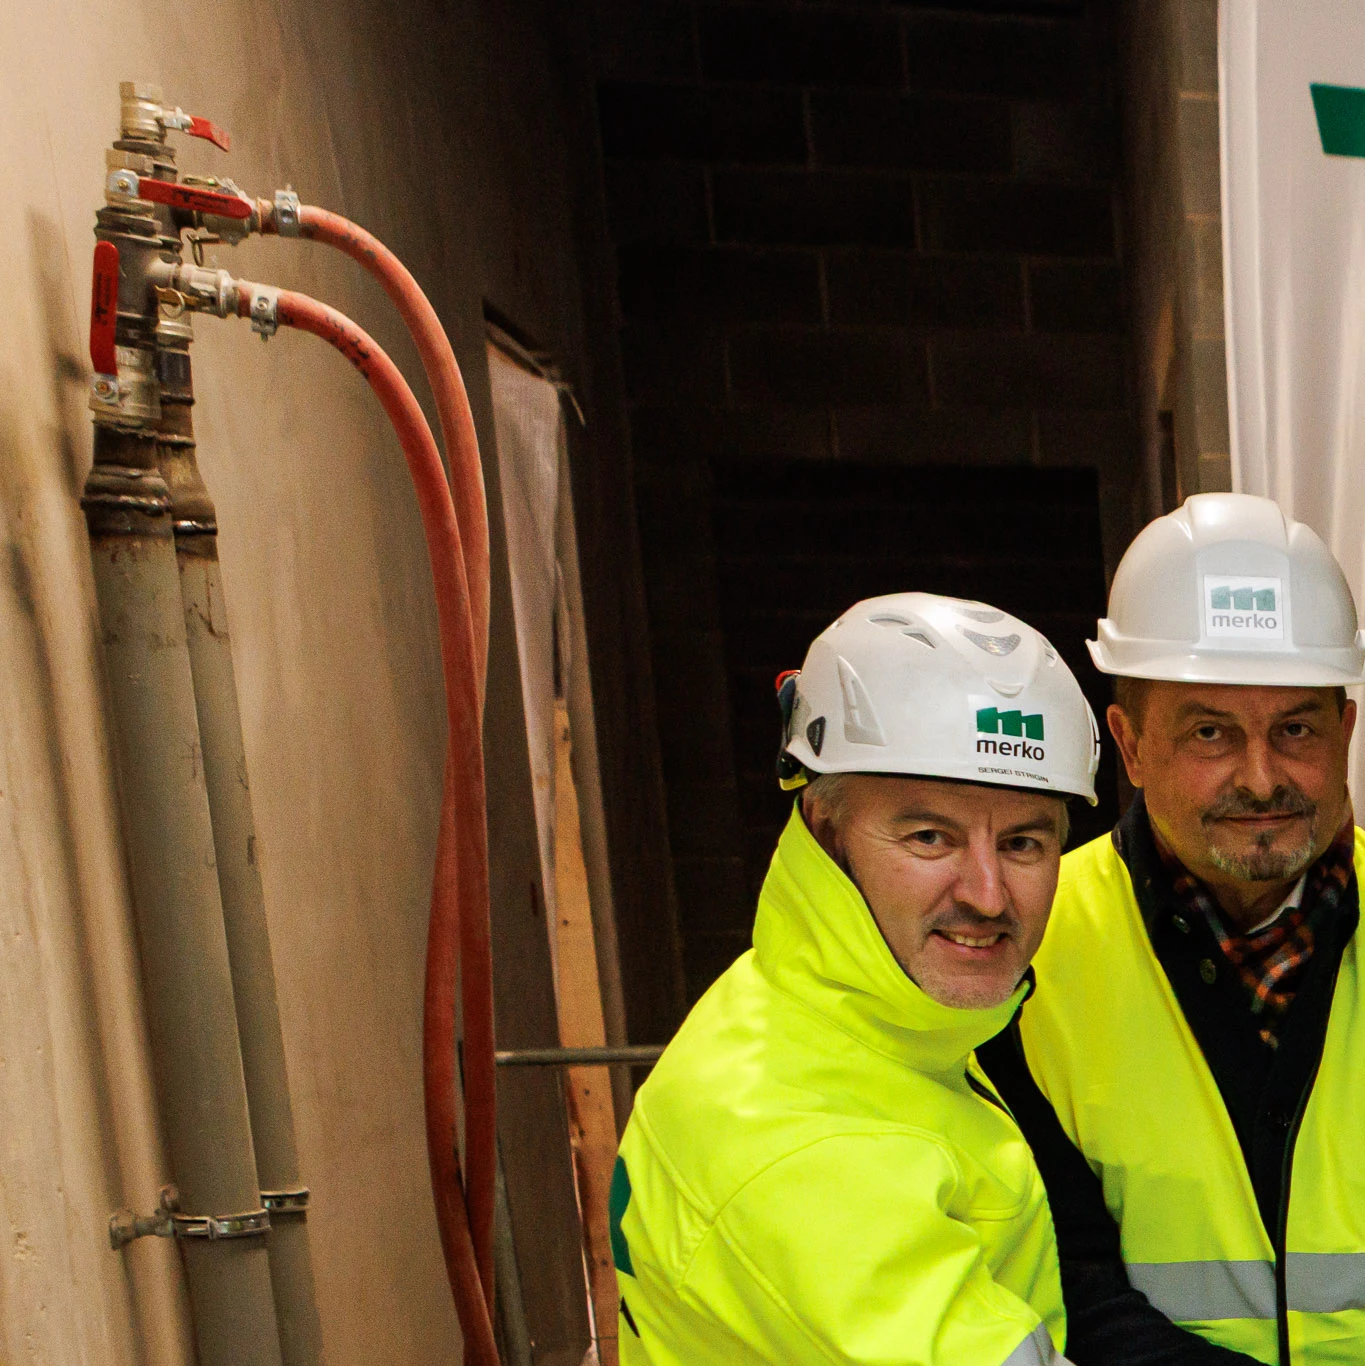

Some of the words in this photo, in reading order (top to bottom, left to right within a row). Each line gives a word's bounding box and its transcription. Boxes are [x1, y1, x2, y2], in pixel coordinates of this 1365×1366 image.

[1211, 613, 1278, 630] merko
[976, 740, 1045, 761] merko
[978, 767, 1013, 775] SERGEI
